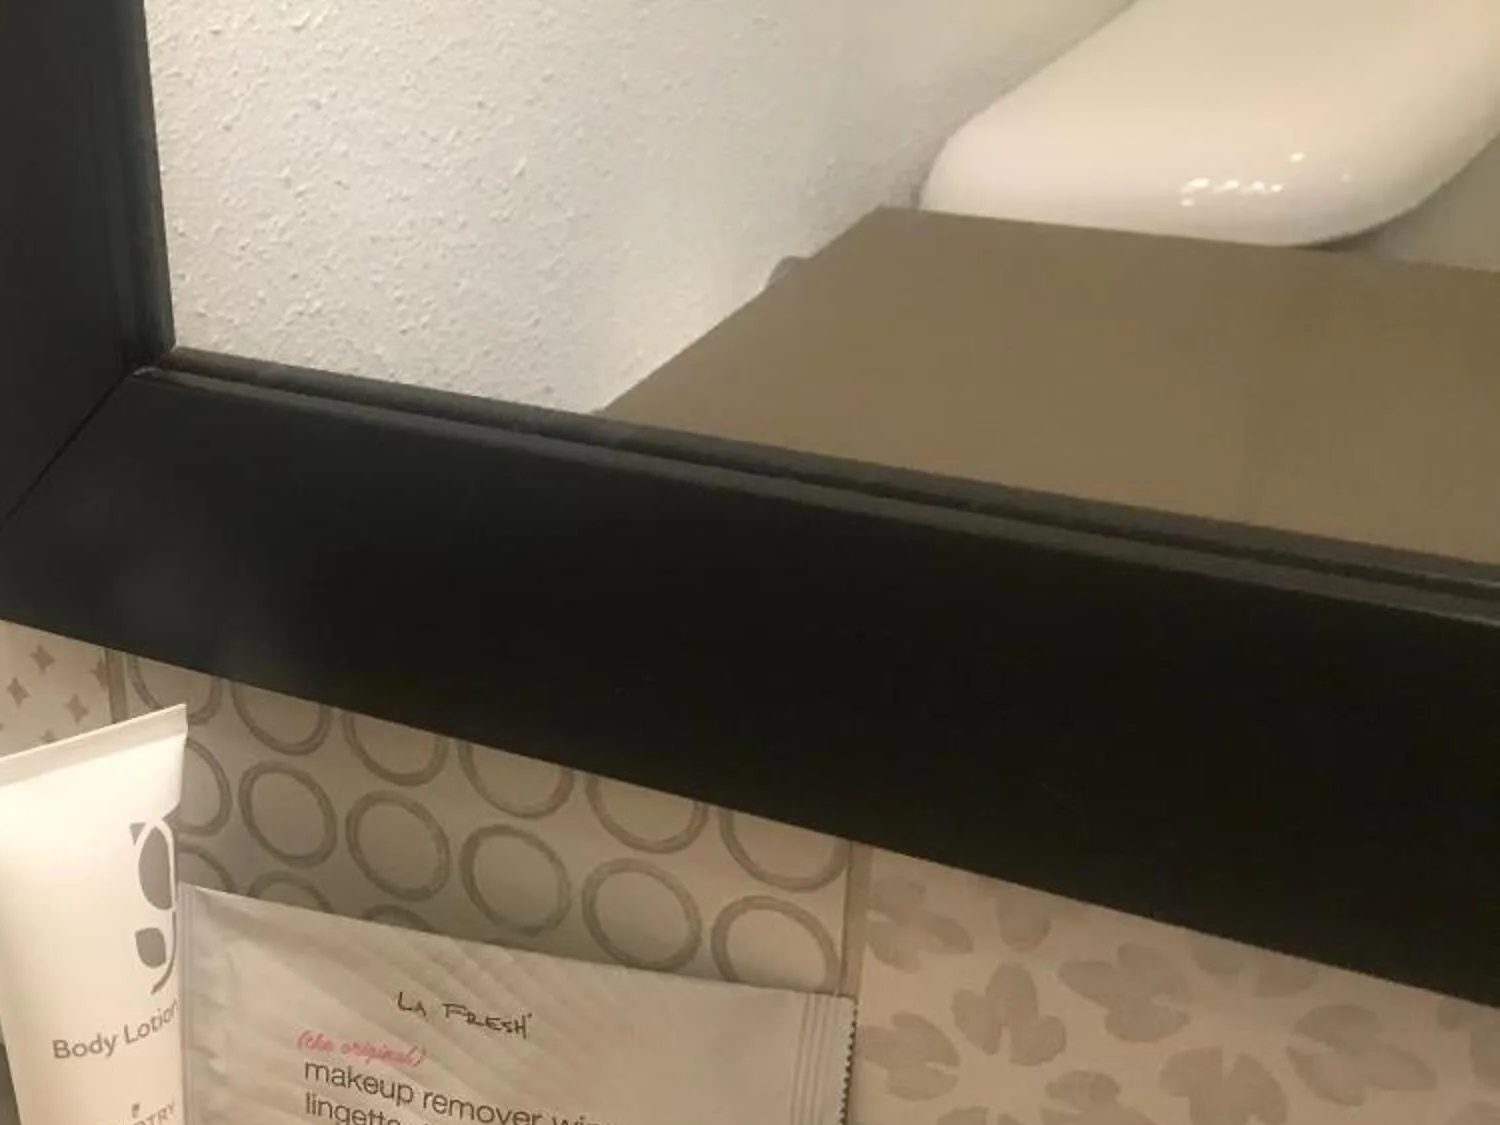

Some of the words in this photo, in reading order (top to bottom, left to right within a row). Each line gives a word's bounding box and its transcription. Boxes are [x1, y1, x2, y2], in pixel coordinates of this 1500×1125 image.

[52, 1033, 119, 1060] Body
[124, 998, 179, 1044] Lotion
[397, 991, 427, 1017] LA
[442, 1003, 527, 1039] FRESH
[304, 1061, 414, 1107] makeup
